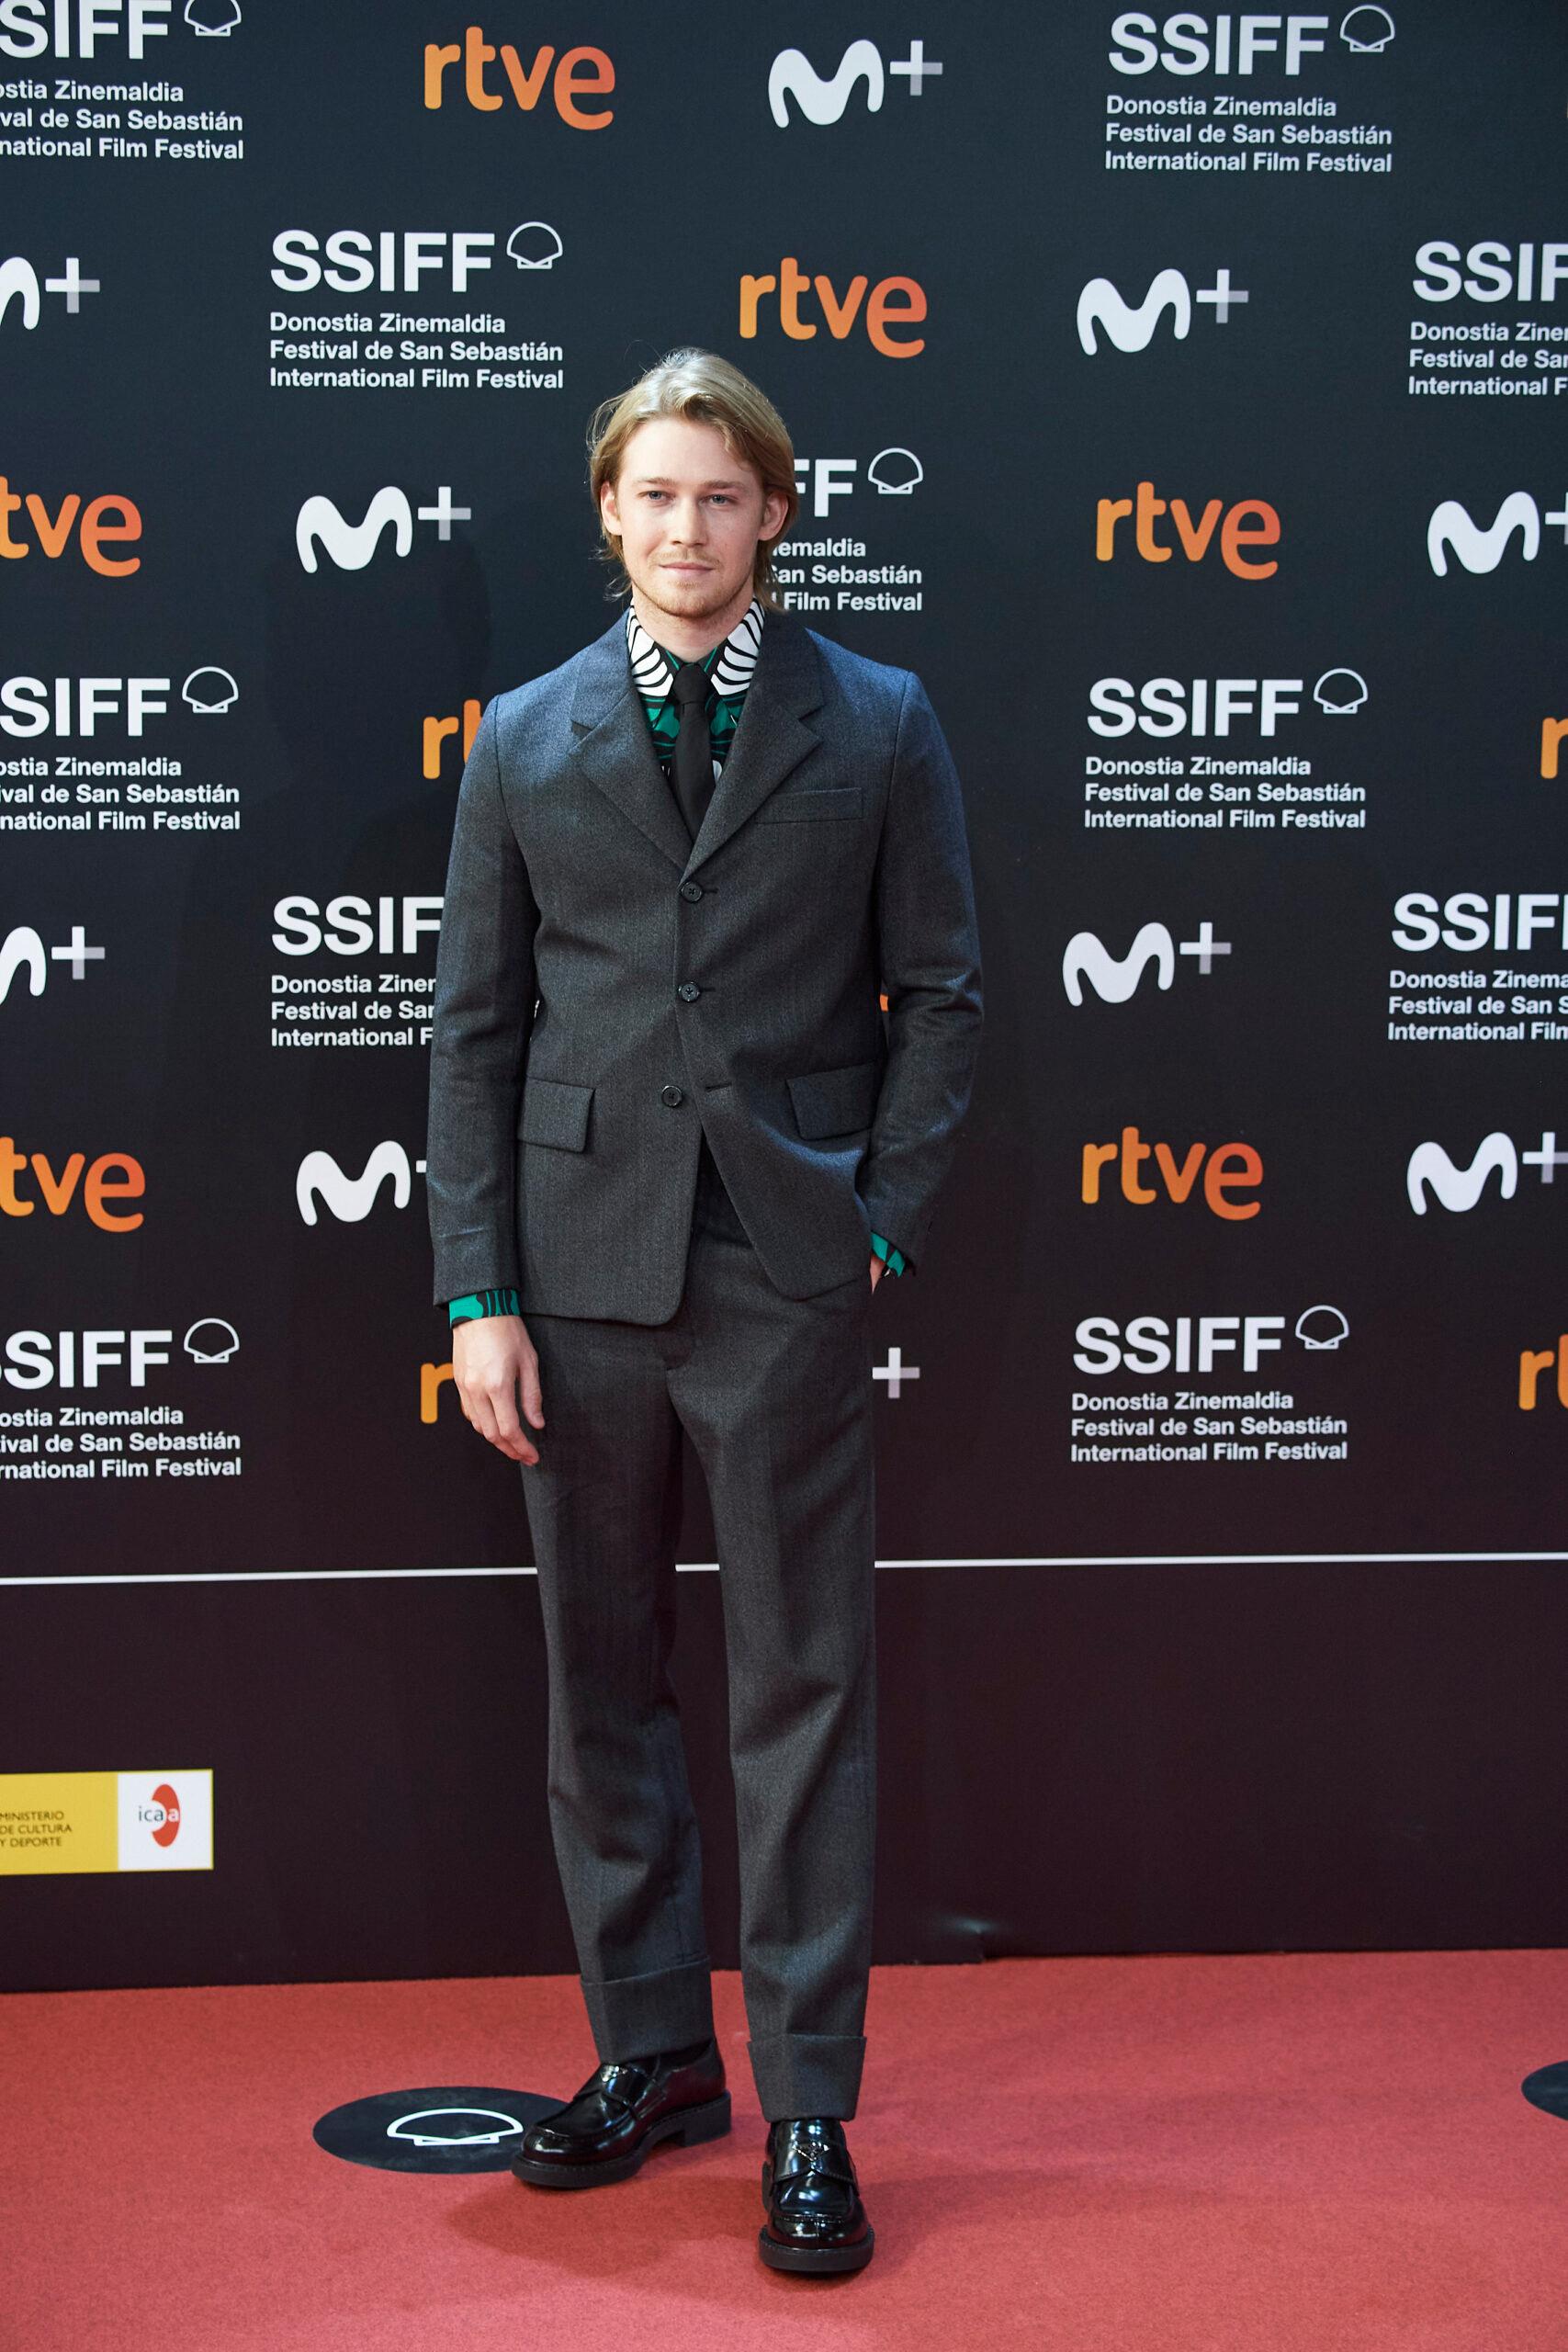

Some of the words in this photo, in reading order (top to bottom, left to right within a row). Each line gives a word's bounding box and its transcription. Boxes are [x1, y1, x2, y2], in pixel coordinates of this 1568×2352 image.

[1108, 12, 1329, 76] SSIFF
[423, 26, 615, 130] rtve
[54, 79, 184, 102] Zinemaldia
[1106, 94, 1207, 116] Donostia
[1213, 96, 1337, 117] Zinemaldia
[39, 107, 70, 129] de
[75, 107, 120, 130] San
[127, 108, 243, 131] Sebastián
[1106, 122, 1192, 143] Festival
[1198, 123, 1226, 143] de
[1232, 123, 1275, 143] San
[1280, 123, 1393, 145] Sebastián
[98, 137, 148, 158] Film
[154, 138, 244, 160] Festival
[1105, 150, 1247, 171] International
[1253, 151, 1300, 172] Film
[1306, 152, 1393, 173] Festival
[270, 229, 495, 293] SSIFF
[739, 257, 928, 358] rtve
[270, 311, 373, 333] Donostia
[378, 312, 506, 334] Zinemaldia
[1410, 321, 1509, 342] Donostia
[1515, 322, 1568, 342] Zine
[270, 339, 358, 360] Festival
[364, 340, 394, 360] de
[399, 340, 444, 361] San
[449, 340, 563, 362] Sebastián
[1409, 348, 1495, 368] Festival
[1500, 349, 1529, 368] de
[1533, 348, 1568, 369] Sa
[270, 367, 415, 388] International
[422, 368, 469, 389] Film
[476, 368, 564, 390] Festival
[1408, 375, 1549, 396] International
[1096, 481, 1281, 581] rtve
[811, 564, 922, 584] Sebastián
[784, 591, 830, 611] Film
[837, 591, 922, 612] Festival
[1087, 677, 1303, 738] SSIFF
[54, 756, 182, 776] Zinemaldia
[1085, 756, 1184, 775] Donostia
[1189, 756, 1312, 775] Zinemaldia
[40, 784, 70, 804] de
[75, 783, 120, 804] San
[126, 783, 240, 804] Sebastián
[1085, 782, 1170, 802] Festival
[1175, 782, 1204, 802] de
[1208, 782, 1251, 802] San
[1257, 782, 1366, 802] Sebastián
[98, 810, 146, 831] Film
[152, 810, 241, 831] Festival
[1084, 808, 1224, 829] International
[1229, 808, 1276, 828] Film
[1281, 808, 1366, 829] Festival
[1391, 892, 1568, 952] SSIF
[271, 974, 372, 994] Donostia
[1389, 969, 1487, 989] Donostia
[271, 1001, 357, 1021] Festival
[364, 1001, 392, 1020] de
[1388, 995, 1472, 1015] Festival
[1477, 995, 1506, 1015] de
[1510, 995, 1553, 1015] San
[271, 1026, 413, 1047] International
[1387, 1022, 1525, 1041] International
[1081, 1126, 1263, 1221] rtve
[1073, 1316, 1286, 1374] SSIFF
[0, 1329, 173, 1390] SIFF
[1071, 1392, 1168, 1411] Donostia
[1174, 1390, 1294, 1410] Zinemaldia
[59, 1406, 184, 1427] Zinemaldia
[1071, 1418, 1155, 1437] Festival
[1159, 1418, 1188, 1436] de
[1193, 1417, 1235, 1436] San
[1240, 1416, 1348, 1435] Sebastián
[44, 1433, 74, 1453] de
[79, 1432, 123, 1453] San
[129, 1430, 241, 1452] Sebastián
[1071, 1442, 1208, 1463] International
[1213, 1442, 1259, 1461] Film
[1264, 1441, 1348, 1461] Festival
[101, 1458, 149, 1478] Film
[155, 1456, 242, 1477] Festival
[18, 1824, 73, 1834] CULTURA
[10, 1837, 62, 1847] DEPORTE
